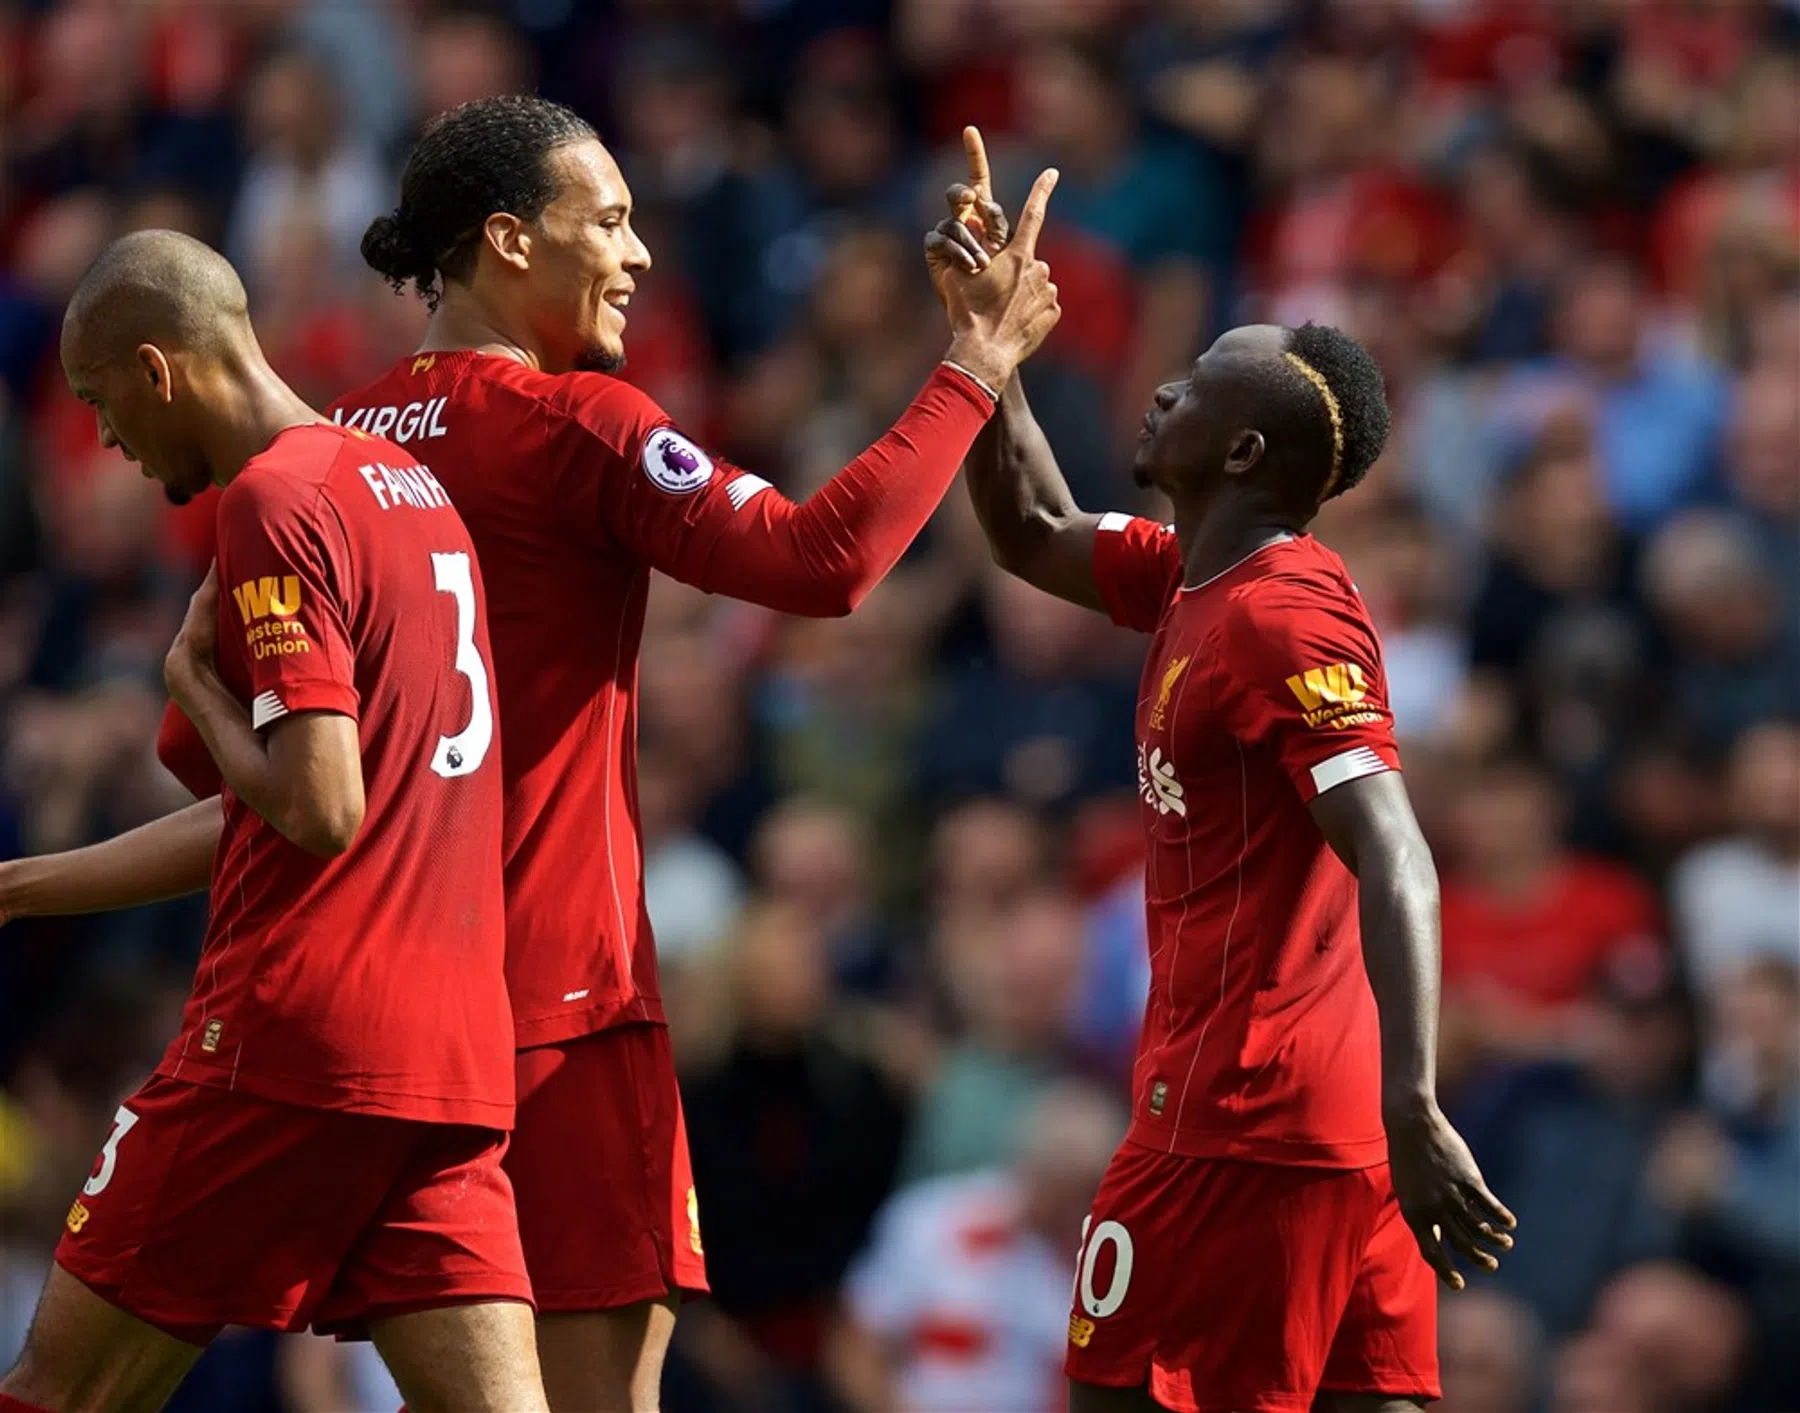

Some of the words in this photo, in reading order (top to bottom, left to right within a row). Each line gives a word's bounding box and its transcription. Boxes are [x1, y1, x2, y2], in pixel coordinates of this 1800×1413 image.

[232, 575, 302, 626] WU
[253, 637, 310, 660] Union
[430, 552, 493, 778] 3
[1285, 663, 1369, 712] WU
[83, 1105, 139, 1196] 3
